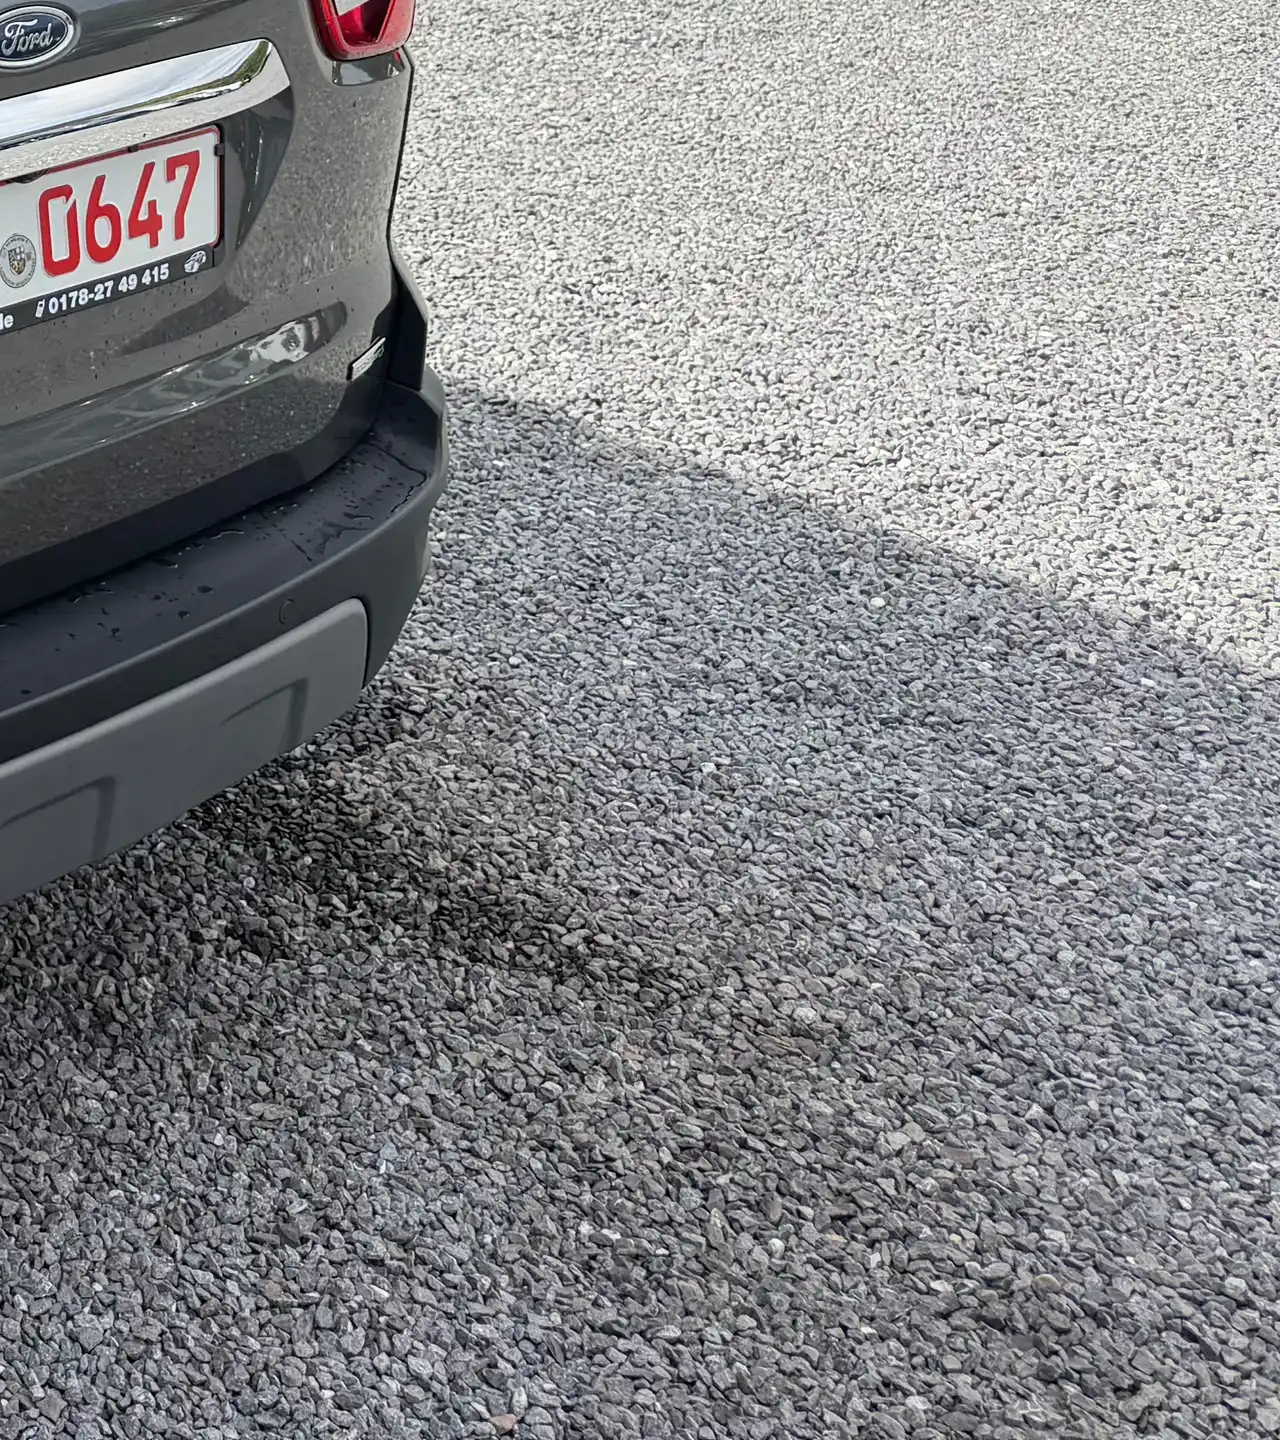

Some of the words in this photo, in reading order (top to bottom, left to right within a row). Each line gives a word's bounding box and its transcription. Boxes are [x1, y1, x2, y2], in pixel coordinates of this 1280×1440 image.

[1, 18, 54, 56] Ford
[39, 149, 201, 278] 0647
[48, 280, 114, 315] 0178-27
[118, 273, 138, 293] 49
[141, 263, 170, 285] 415
